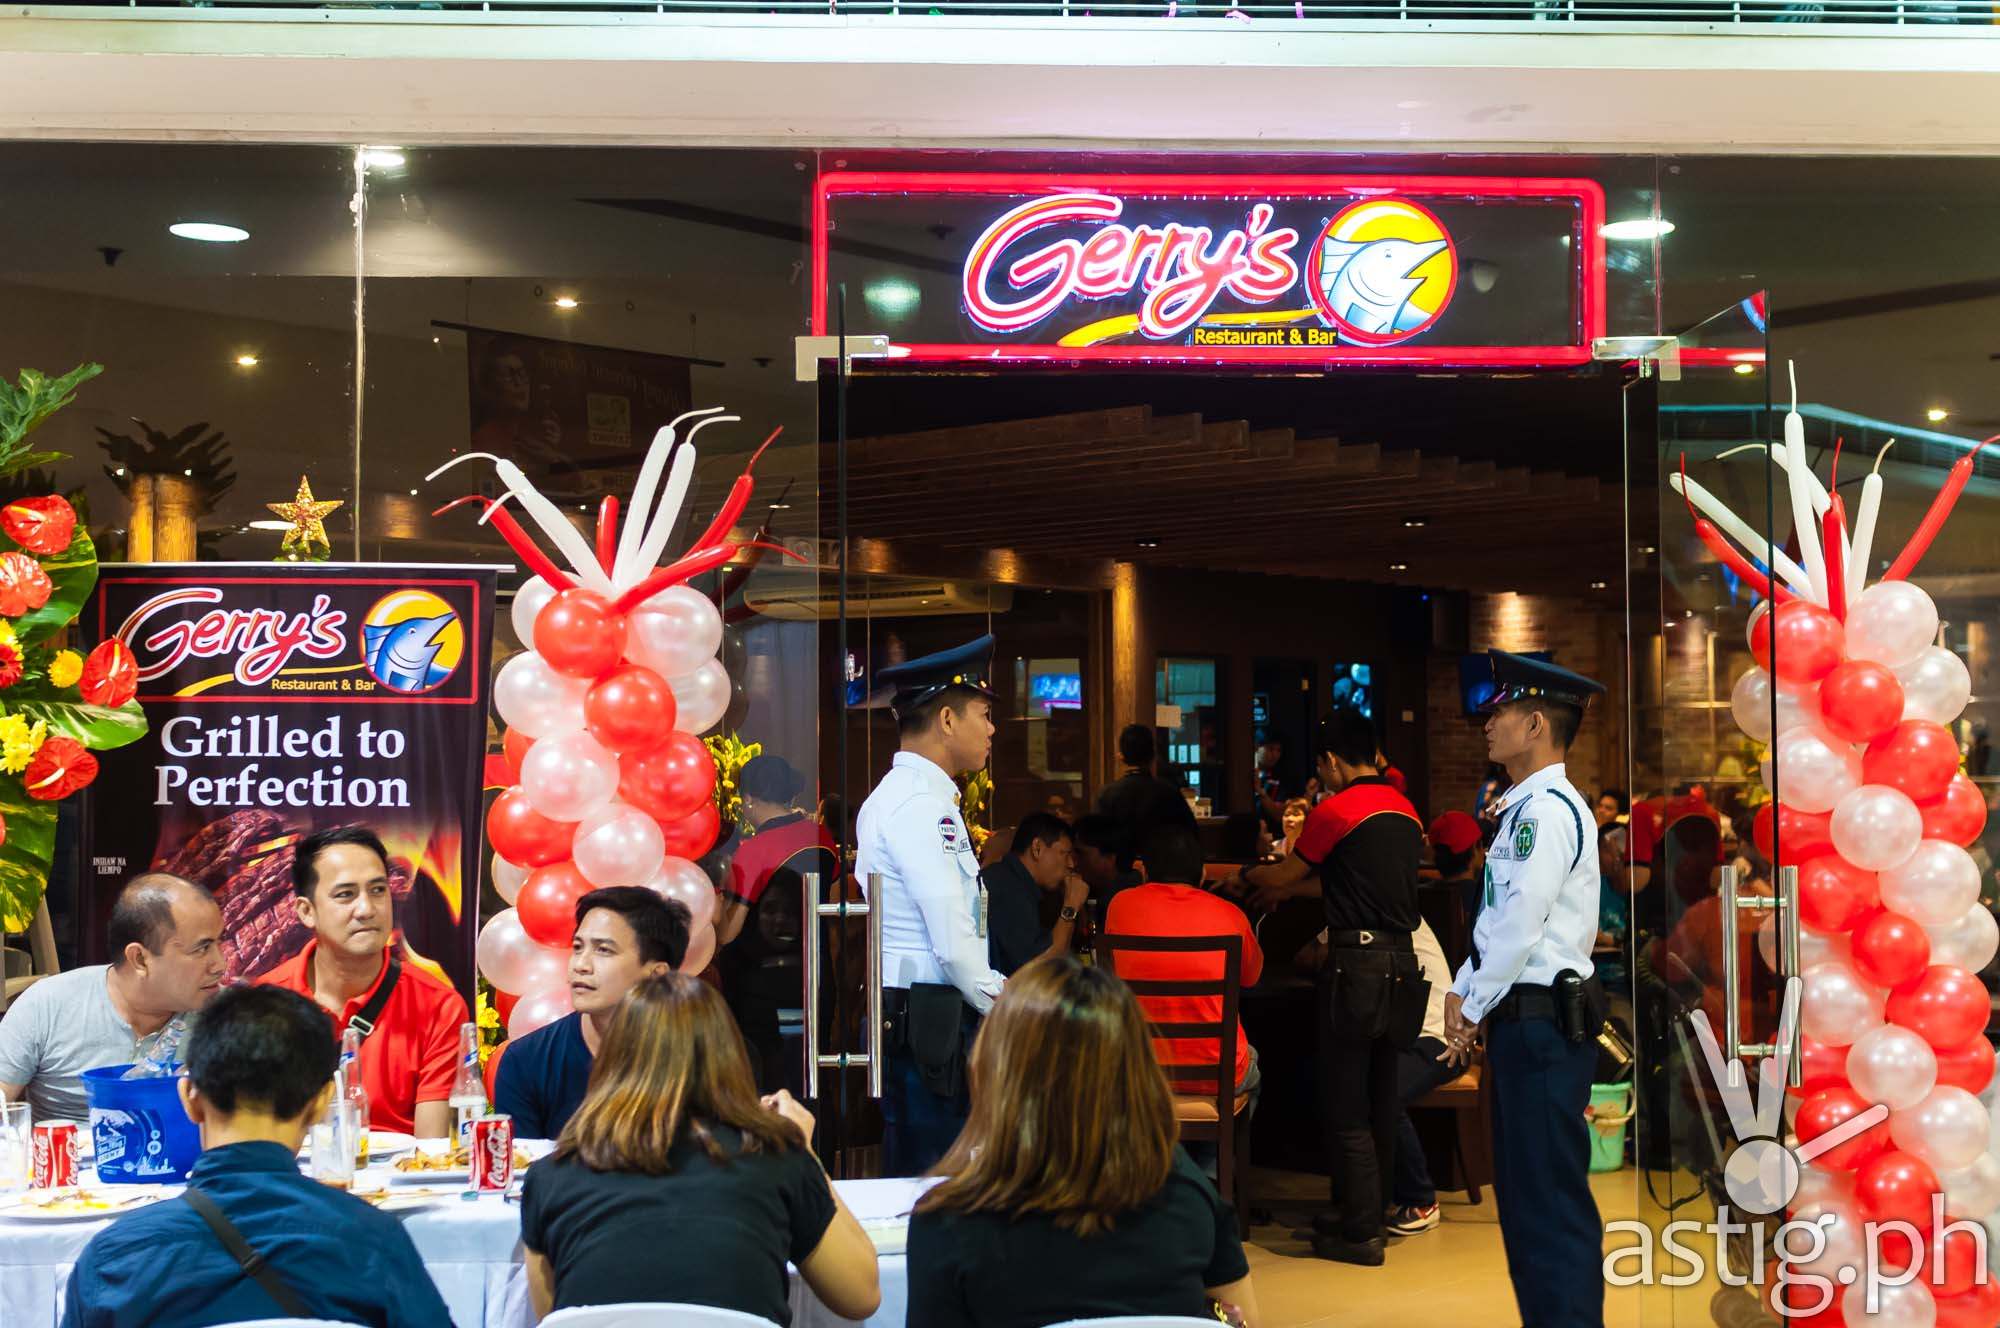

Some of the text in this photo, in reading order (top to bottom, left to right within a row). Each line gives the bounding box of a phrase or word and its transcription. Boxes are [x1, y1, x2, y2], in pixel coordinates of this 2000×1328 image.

[963, 193, 1299, 338] Gerry's
[1195, 328, 1338, 345] Restaurant & Bar
[116, 587, 348, 685] Gerry's
[271, 679, 377, 691] Restaurant & Bar
[161, 715, 405, 759] Grilled to
[153, 763, 411, 808] Perfection
